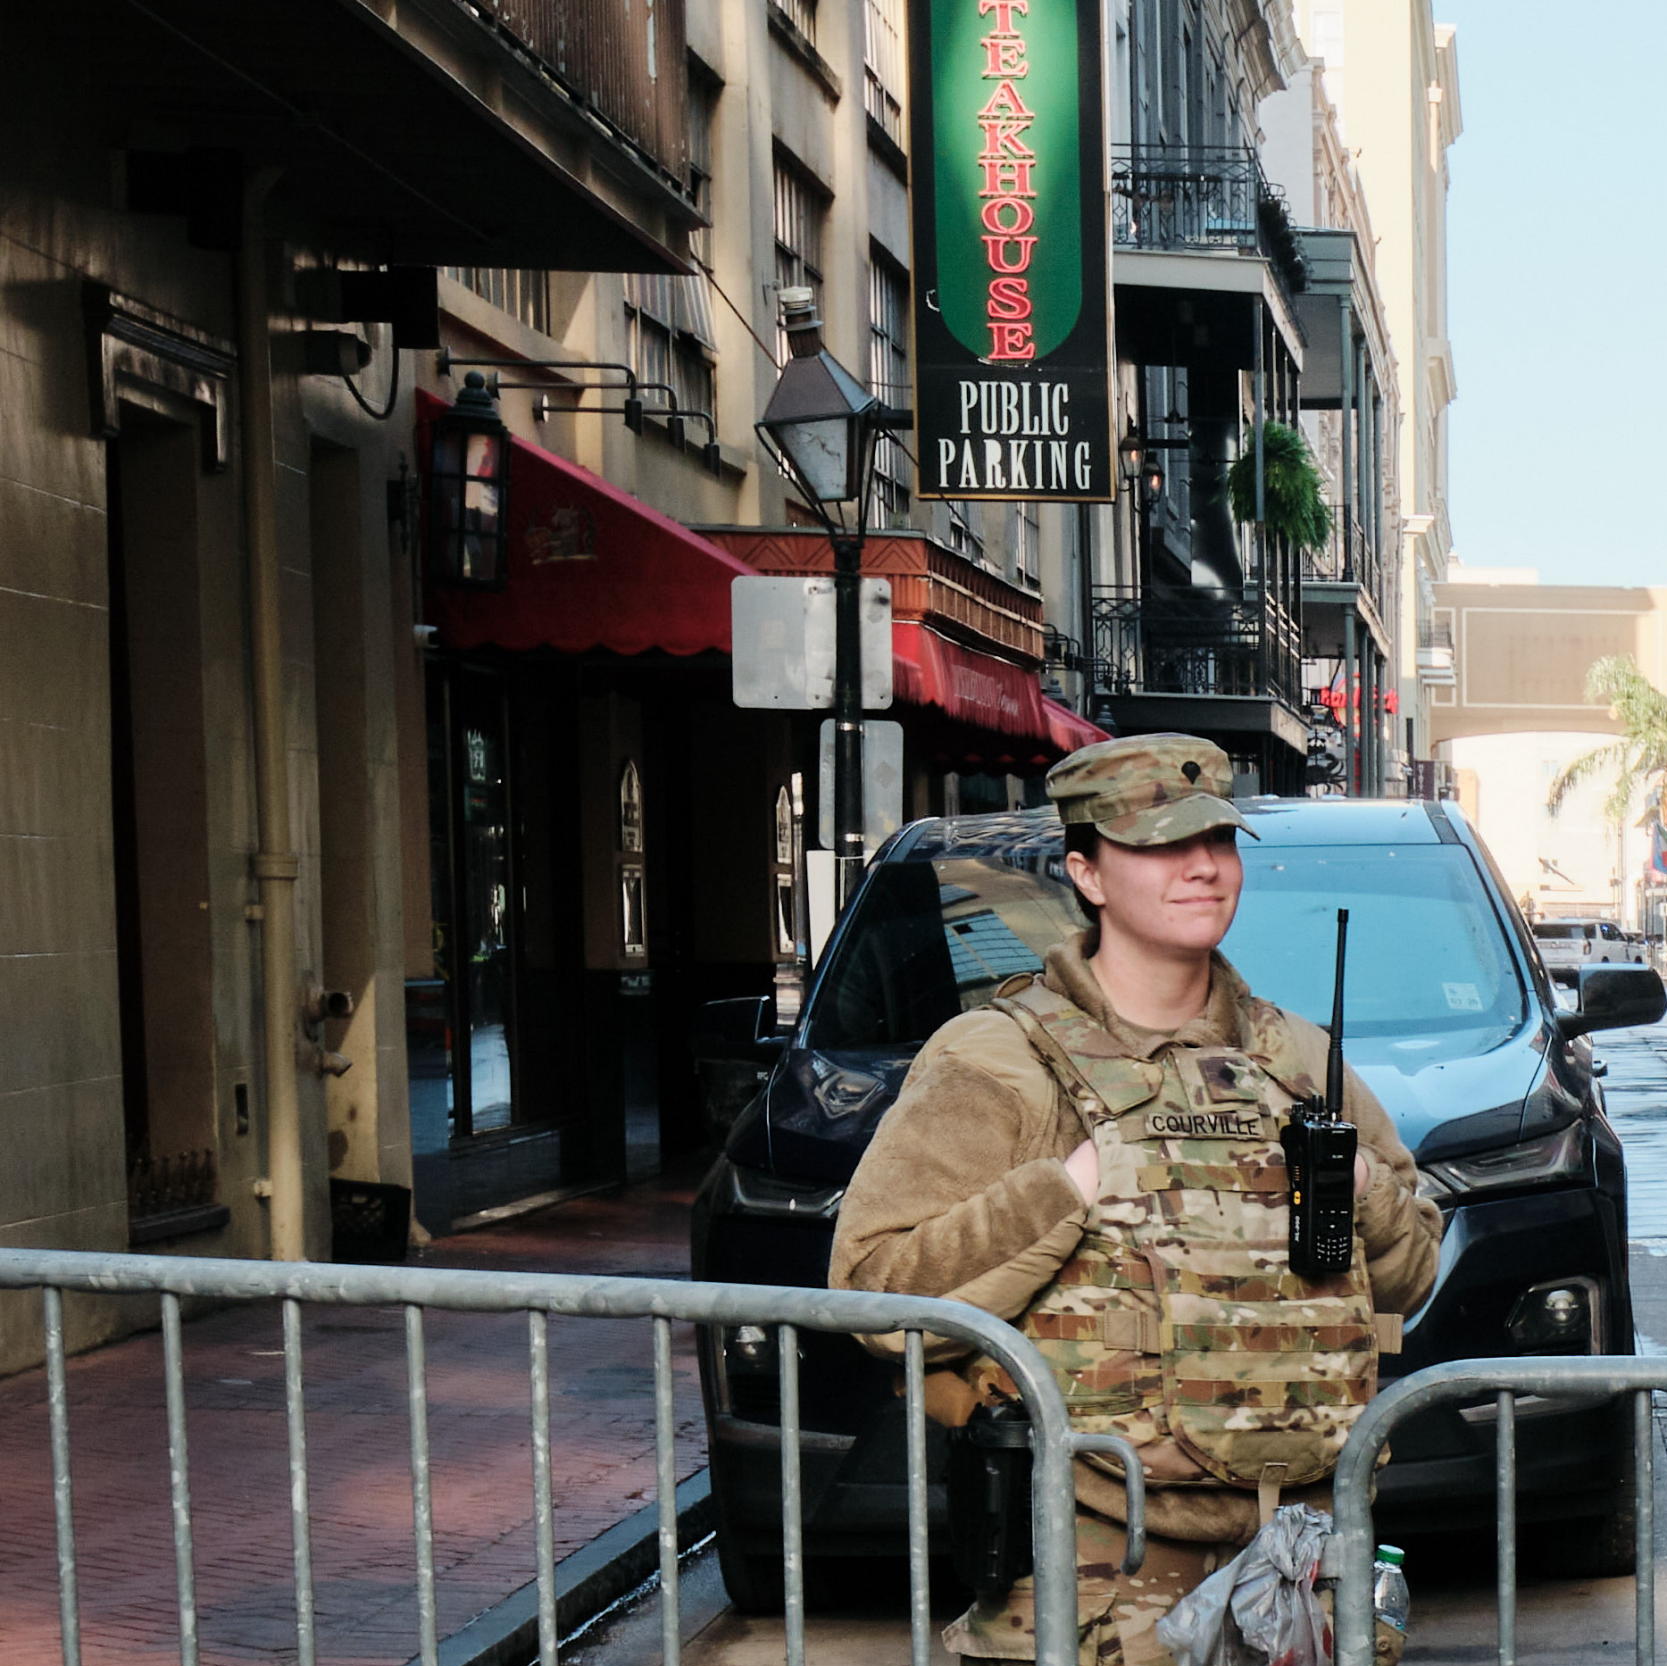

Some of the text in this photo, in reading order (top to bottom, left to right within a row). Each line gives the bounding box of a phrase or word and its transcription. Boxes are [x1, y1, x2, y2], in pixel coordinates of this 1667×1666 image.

[959, 380, 1070, 437] PUBLIC
[938, 438, 1092, 490] PARKING
[1152, 1115, 1260, 1136] COURVILLE
